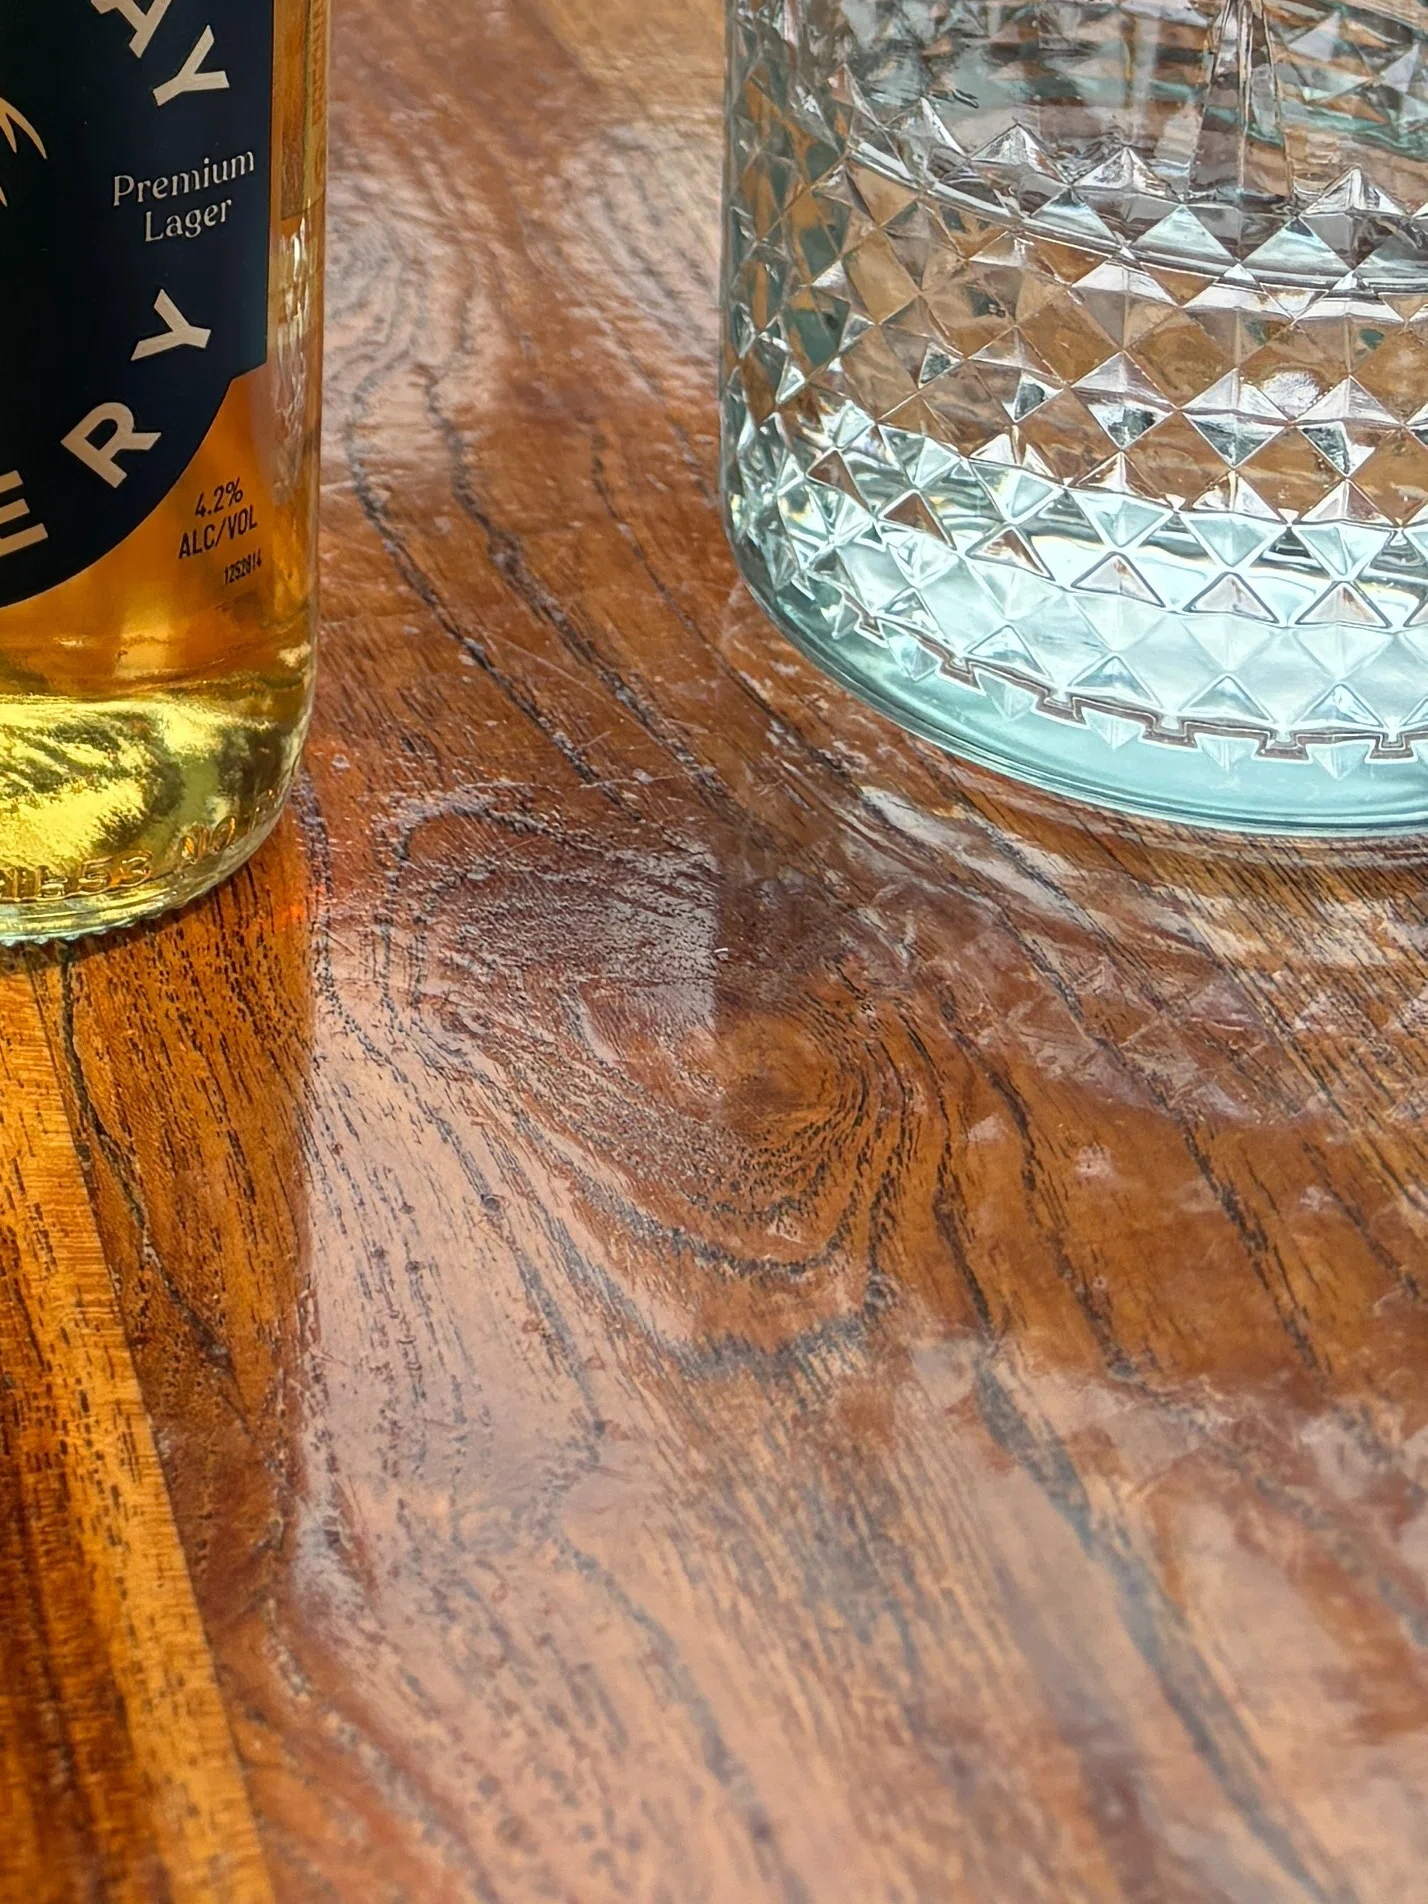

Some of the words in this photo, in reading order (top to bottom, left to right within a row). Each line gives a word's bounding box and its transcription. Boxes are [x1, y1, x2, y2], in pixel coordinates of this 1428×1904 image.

[113, 151, 254, 207] Premium
[145, 199, 232, 242] Lager
[195, 477, 244, 517] 4.2%
[178, 504, 258, 559] ALC/VOL
